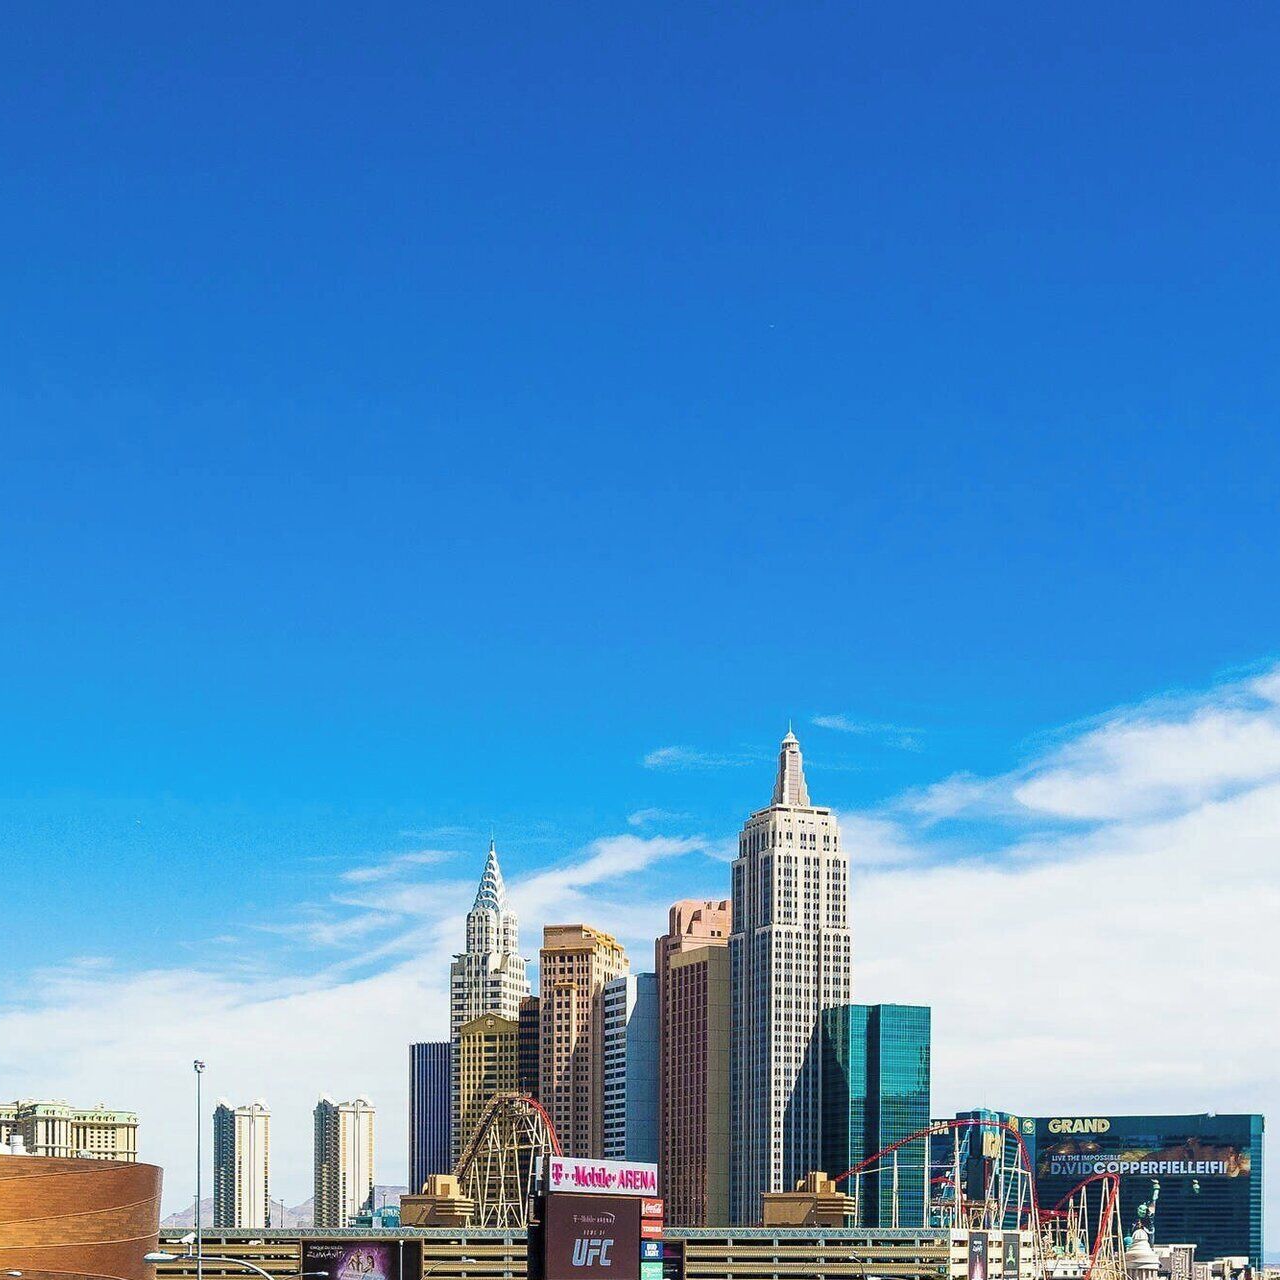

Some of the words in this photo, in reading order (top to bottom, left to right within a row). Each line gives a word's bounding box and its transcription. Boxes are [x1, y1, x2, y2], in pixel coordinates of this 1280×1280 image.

[1048, 1119, 1111, 1134] GRAND
[616, 1169, 656, 1191] ARENA
[572, 1238, 614, 1266] UFC
